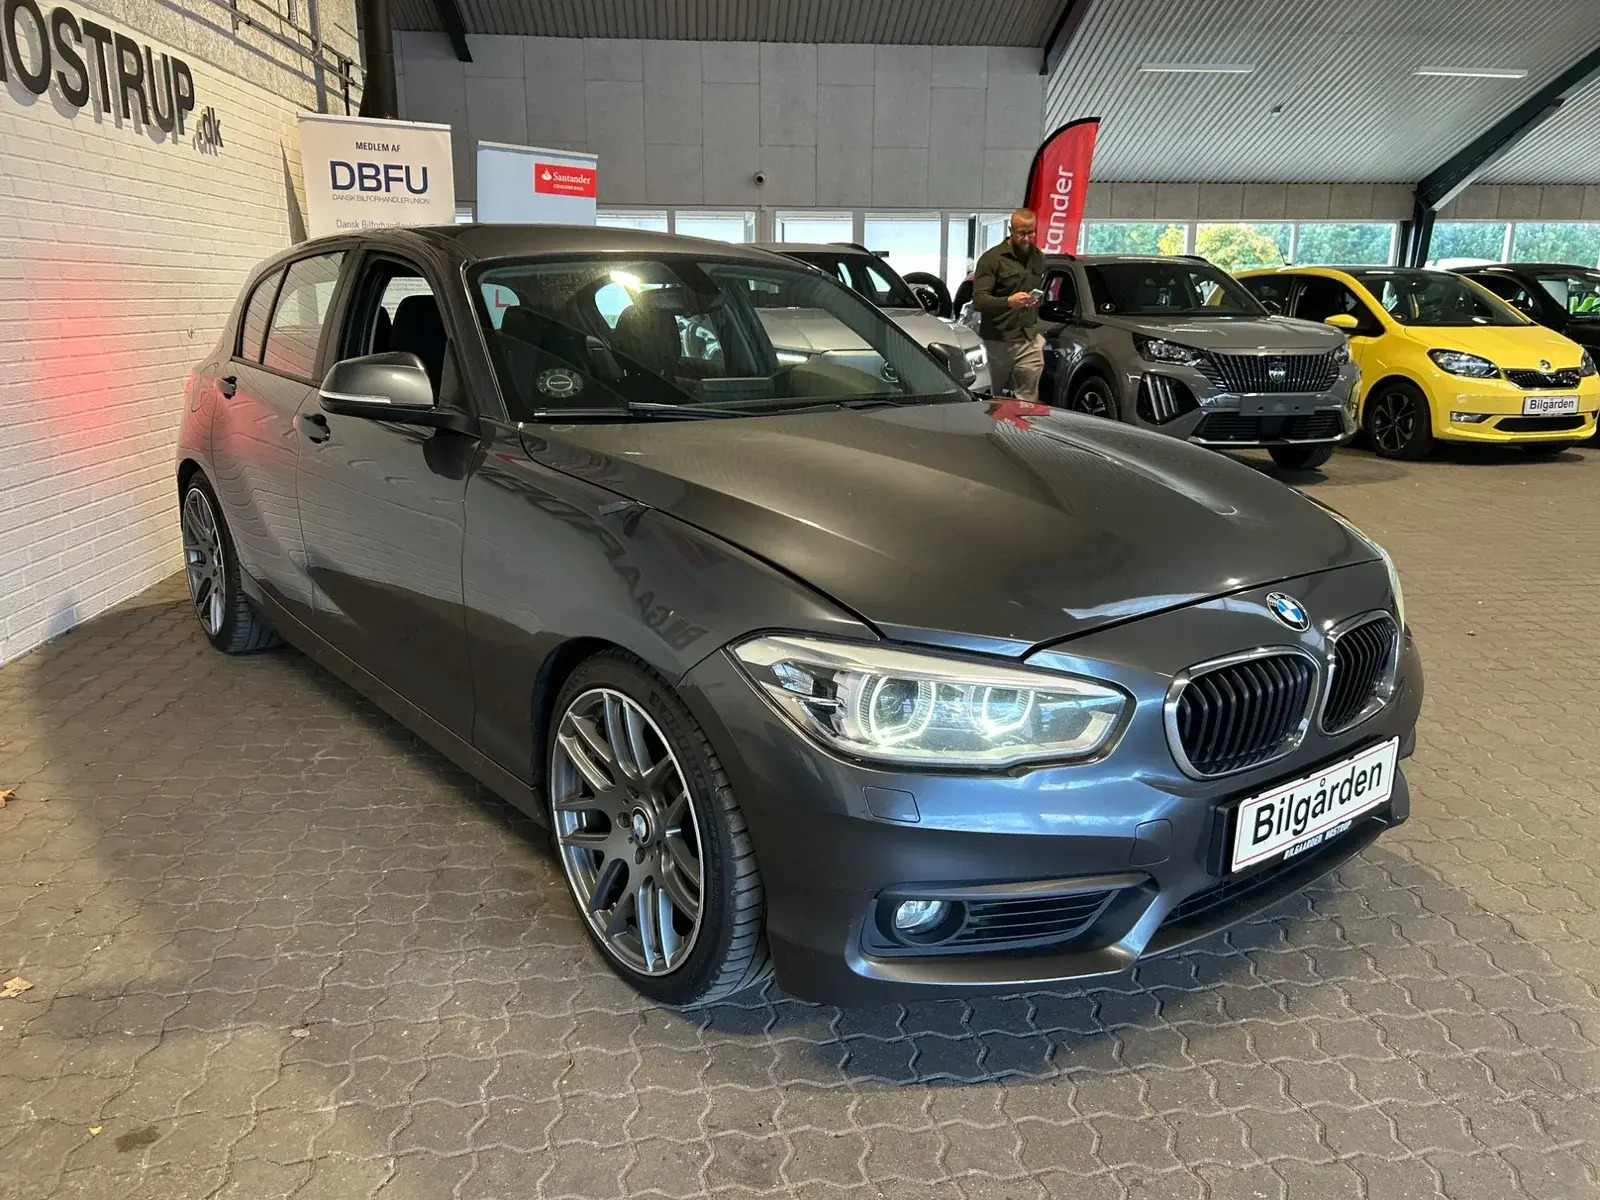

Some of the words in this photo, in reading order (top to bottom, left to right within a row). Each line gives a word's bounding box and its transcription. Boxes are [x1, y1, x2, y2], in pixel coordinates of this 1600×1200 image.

[356, 141, 390, 152] MEDLEM
[391, 144, 401, 152] AF
[329, 160, 429, 195] DBFU
[552, 171, 591, 184] Santander
[332, 193, 356, 201] DANSK
[336, 219, 359, 229] Dansk
[1252, 761, 1383, 846] Bilgården
